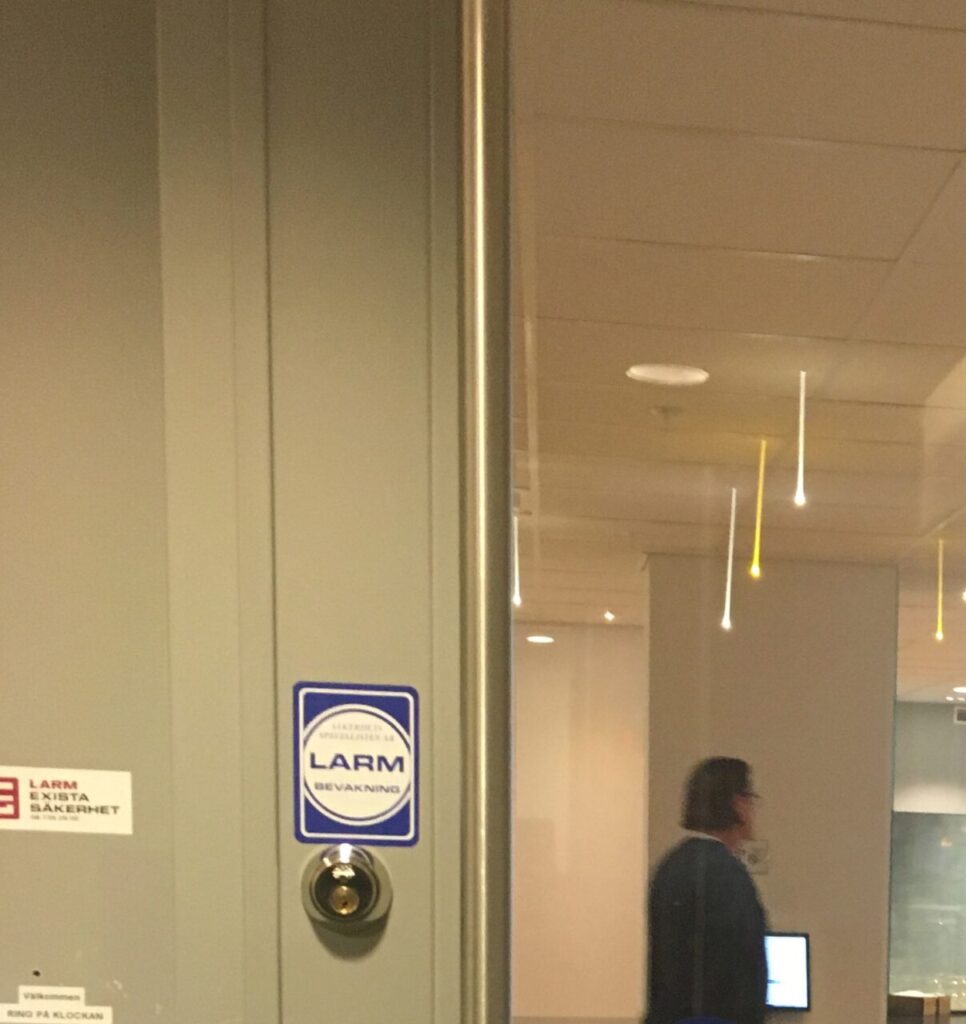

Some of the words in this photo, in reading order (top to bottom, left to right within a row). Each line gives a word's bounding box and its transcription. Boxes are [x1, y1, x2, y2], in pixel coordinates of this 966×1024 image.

[309, 752, 405, 773] LARM
[29, 779, 78, 790] LARM
[314, 782, 401, 794] BEVAKNING
[29, 791, 90, 802] EXISTA
[30, 803, 120, 815] SÄKERHET
[7, 1009, 33, 1018] RING
[36, 1010, 50, 1019] PÅ
[53, 1011, 104, 1020] KLOCKAN
